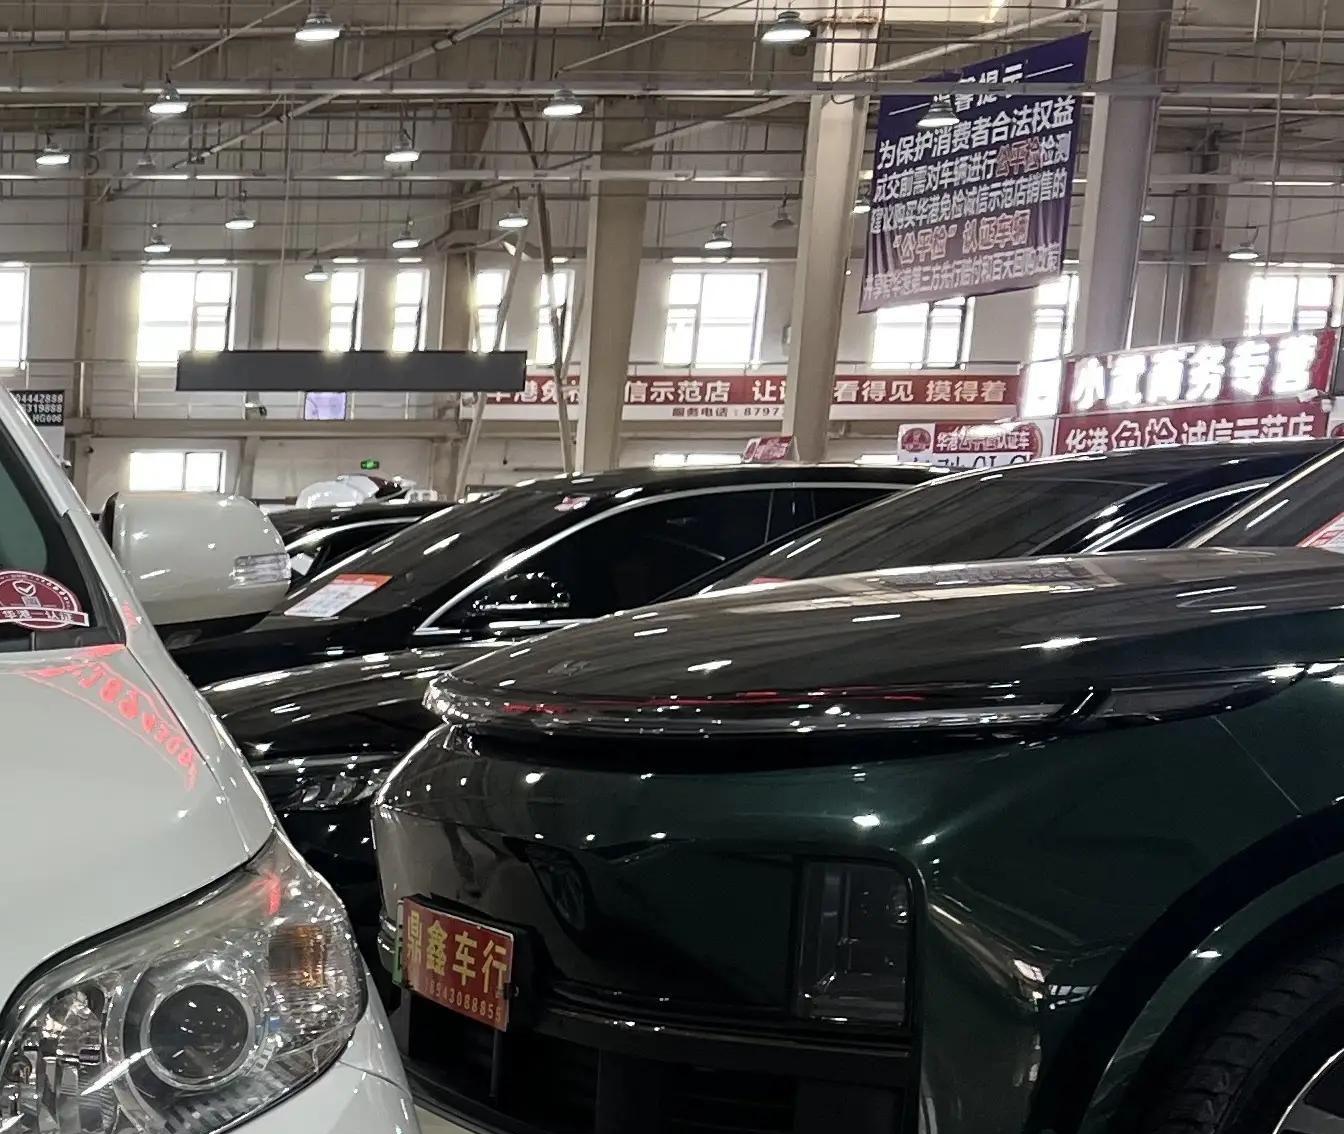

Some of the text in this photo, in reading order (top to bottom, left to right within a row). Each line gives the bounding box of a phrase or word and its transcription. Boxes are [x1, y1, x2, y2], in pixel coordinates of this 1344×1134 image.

[876, 94, 1076, 171] 为保护消费者合法权益
[925, 380, 1007, 403] 摸得着
[407, 909, 508, 995] 鼎鑫车行
